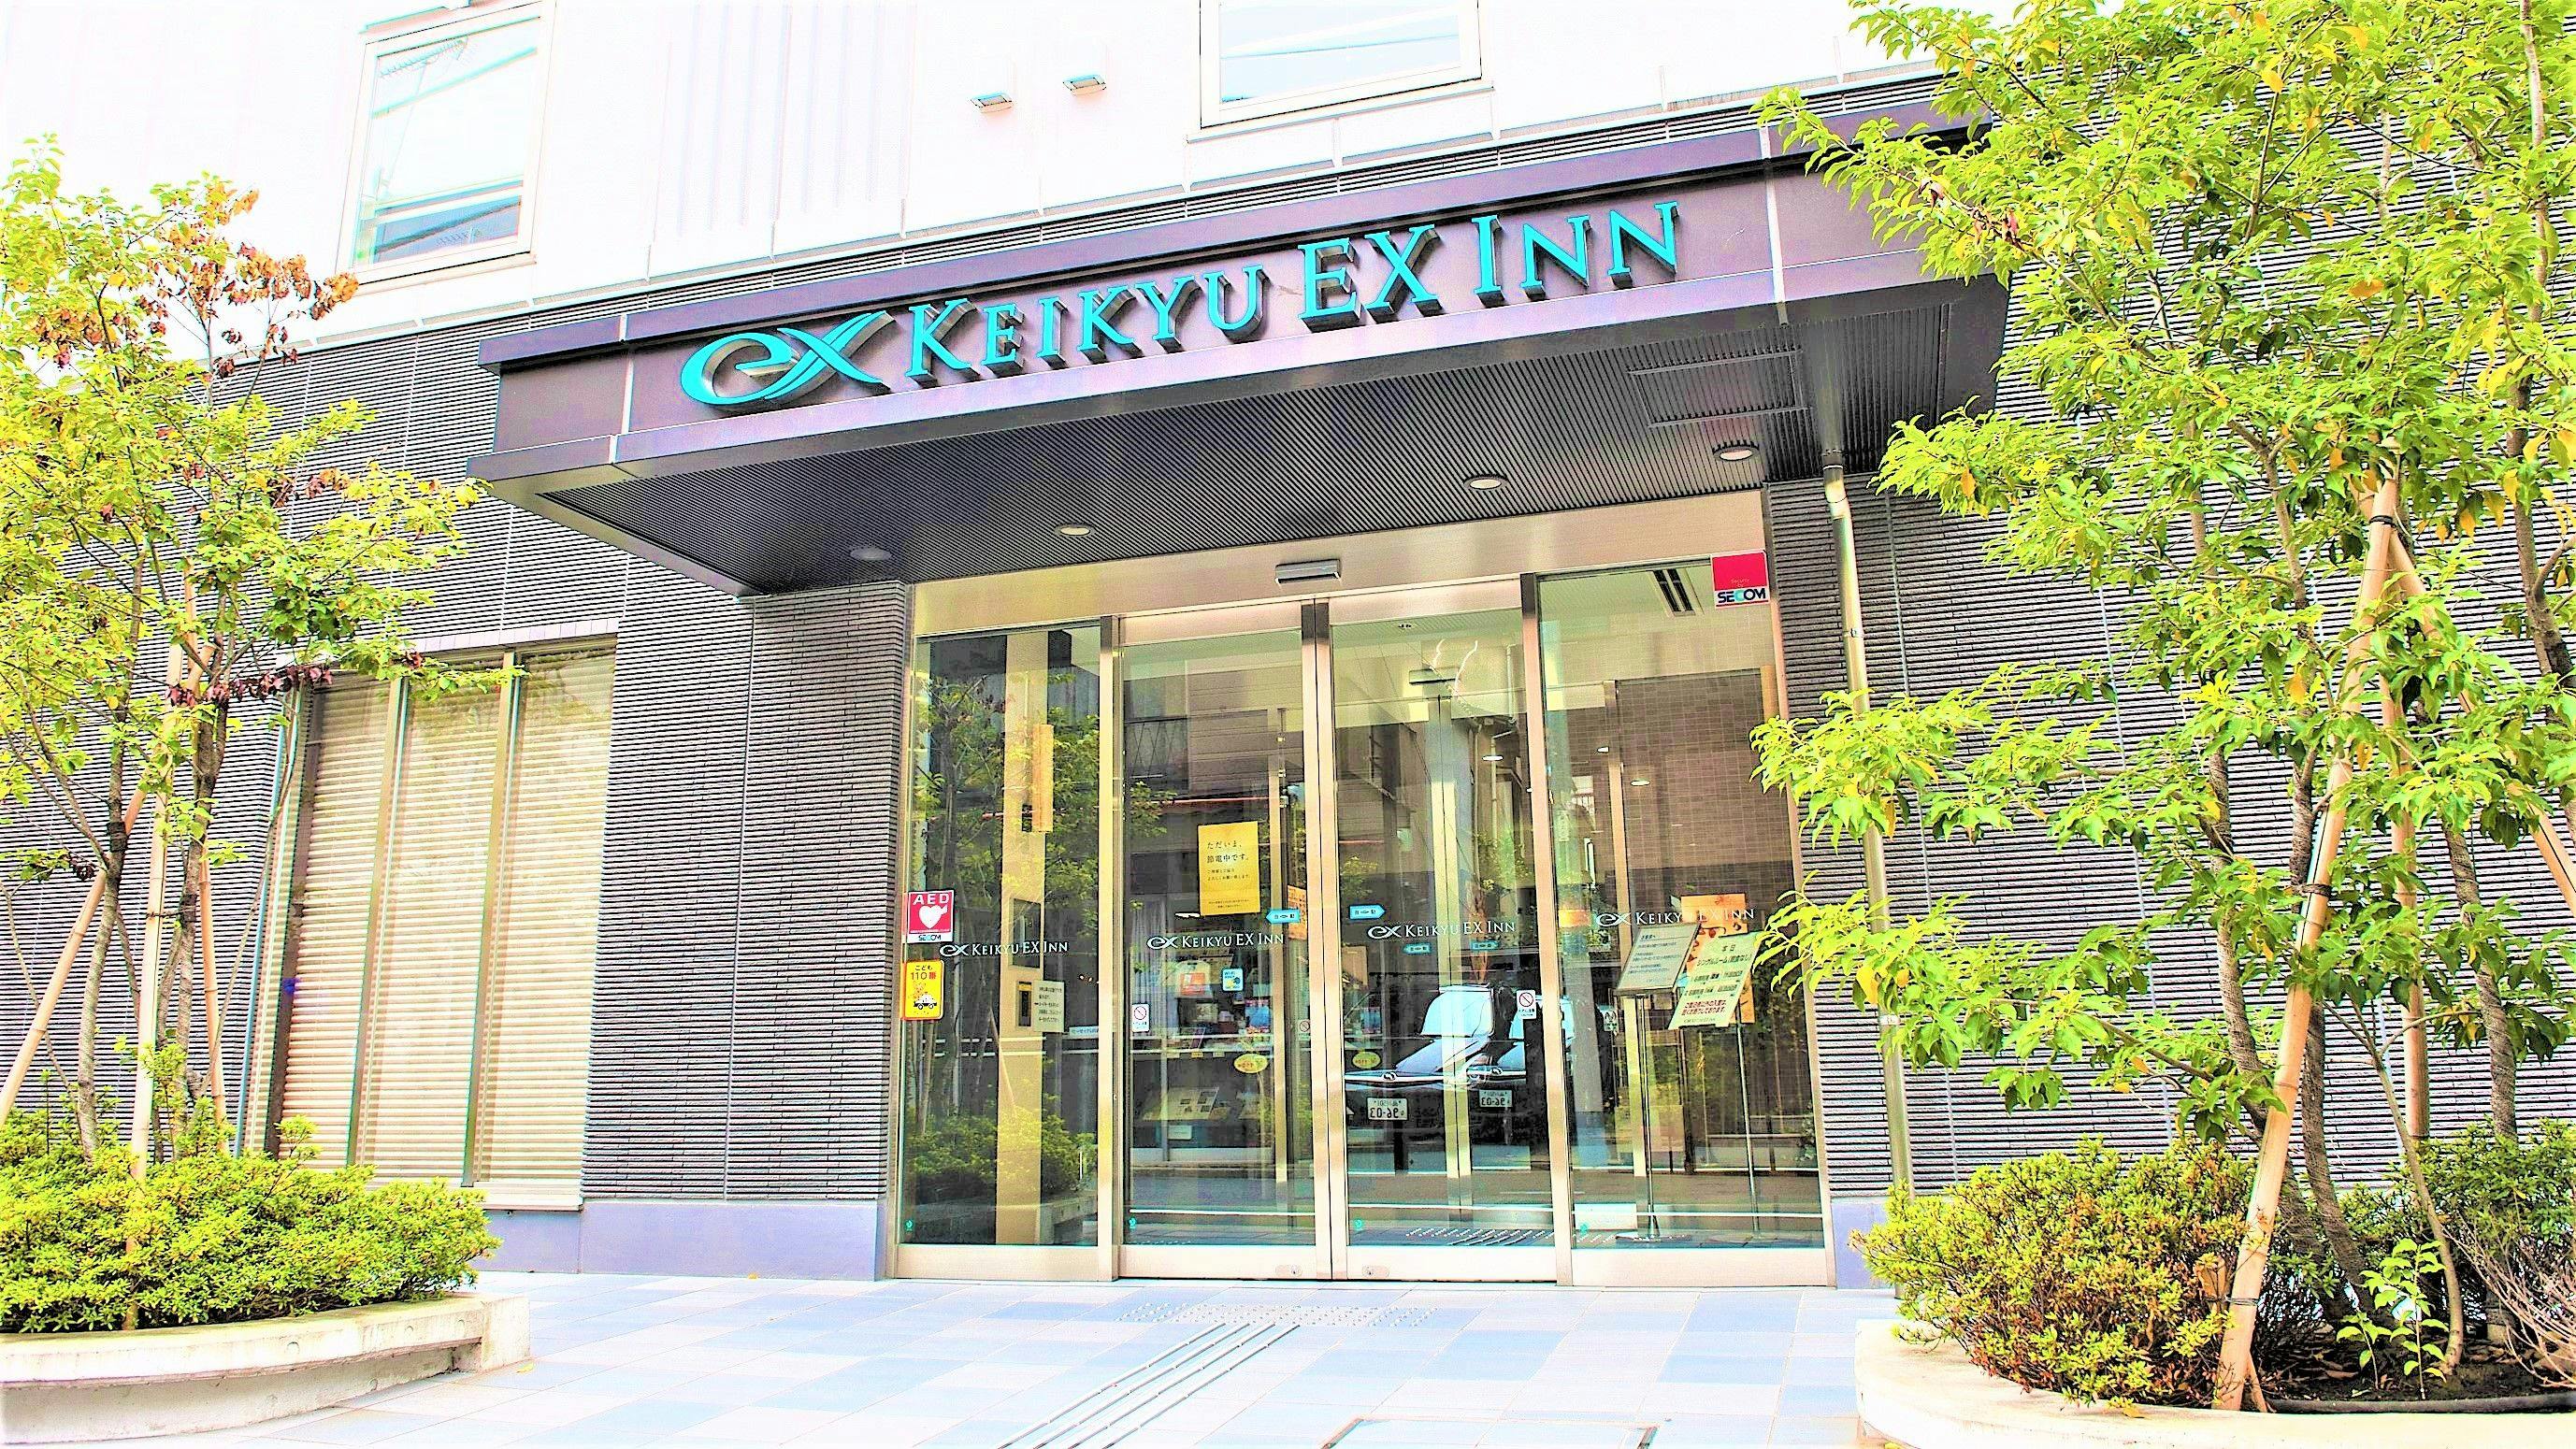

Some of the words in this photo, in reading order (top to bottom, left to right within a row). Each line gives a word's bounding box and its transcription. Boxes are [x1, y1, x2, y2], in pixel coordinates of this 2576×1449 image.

[904, 265, 1268, 381] KEIKYU
[1298, 224, 1438, 323] EX
[1471, 201, 1679, 295] INN
[1717, 587, 1766, 604] SECOM
[912, 893, 950, 905] AED
[1635, 911, 1688, 925] KEIKY
[1724, 908, 1755, 921] INN
[1405, 924, 1460, 938] KEIKYU
[1463, 921, 1483, 934] EX
[1488, 920, 1516, 933] INN
[972, 943, 1019, 956] KEIKYU
[1022, 942, 1041, 954] EX
[1043, 940, 1069, 953] INN
[1182, 935, 1232, 948] KEIKYU
[1236, 933, 1254, 946] EX
[1258, 932, 1284, 944] INN
